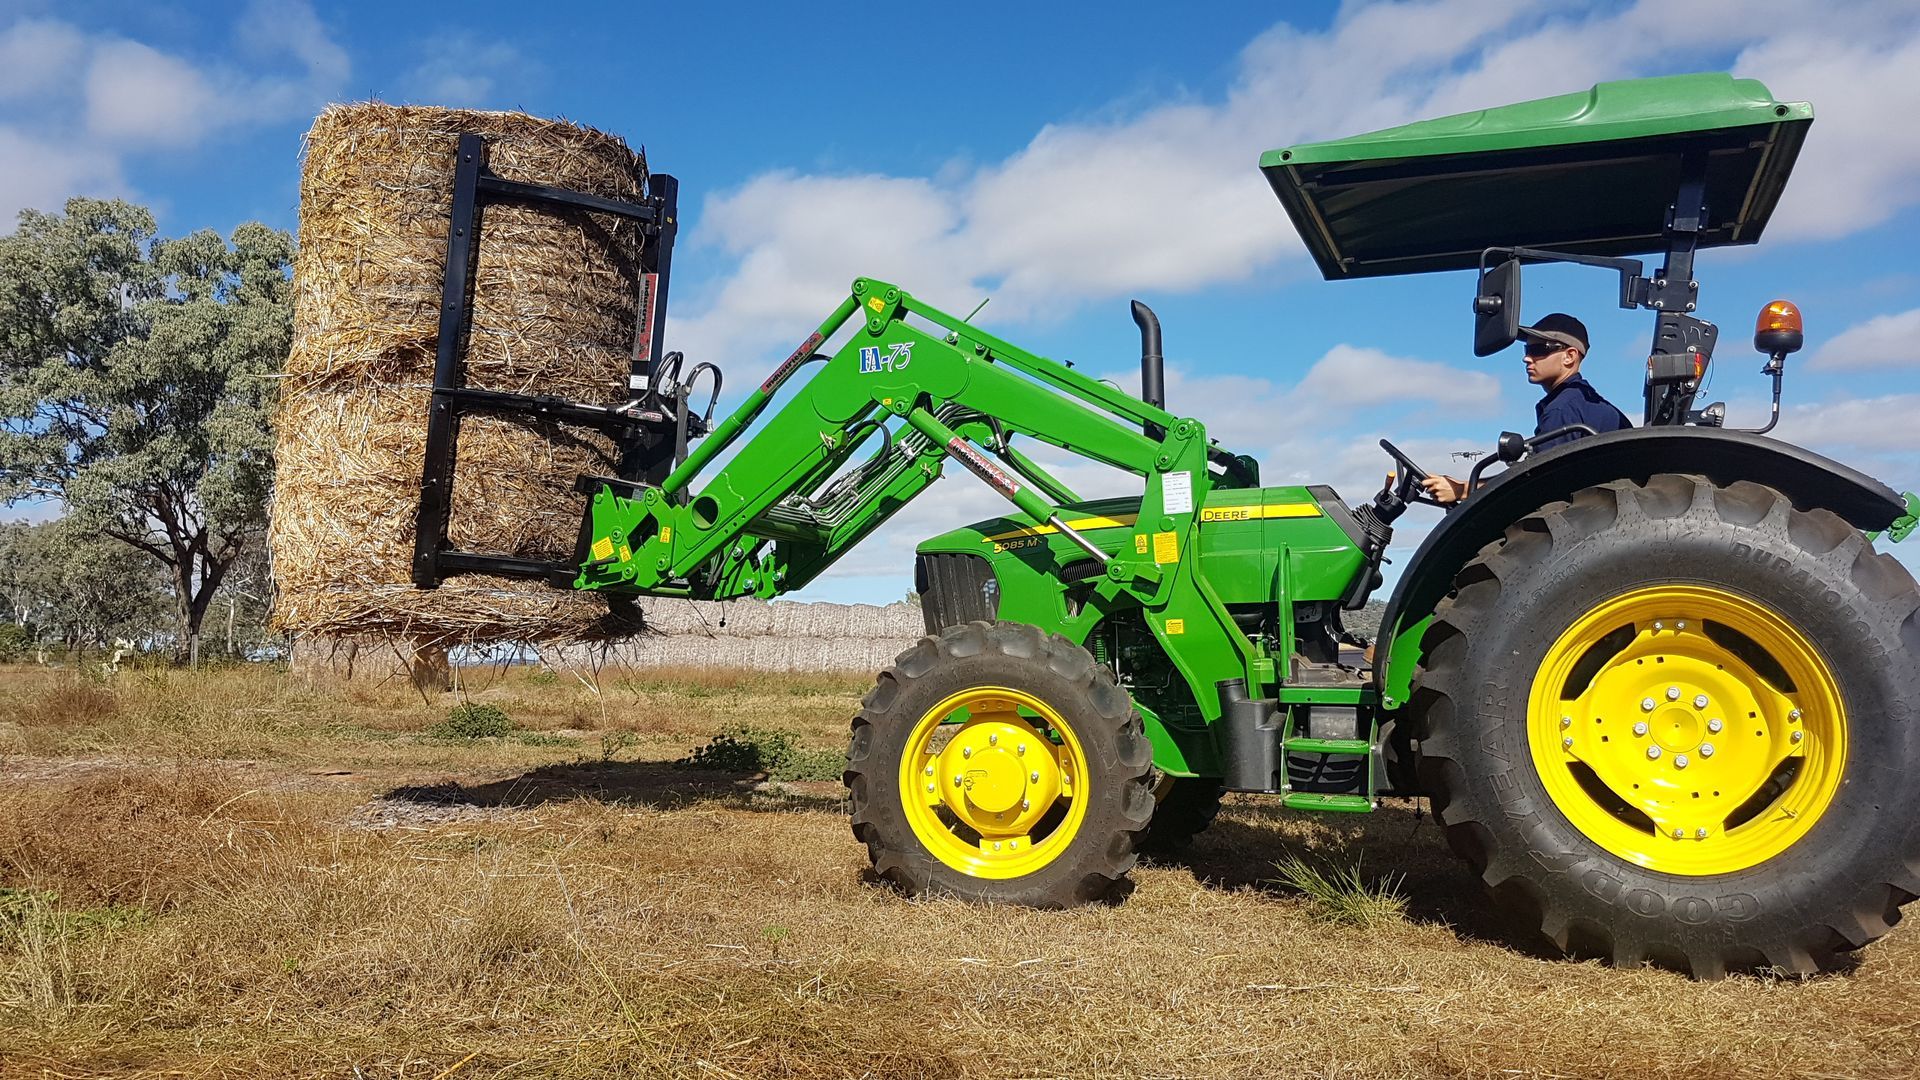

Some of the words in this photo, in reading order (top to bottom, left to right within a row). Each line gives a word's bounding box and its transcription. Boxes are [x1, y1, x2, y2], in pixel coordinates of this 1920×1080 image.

[1203, 510, 1249, 521] DEERE
[993, 540, 1025, 554] 5085
[1027, 538, 1038, 548] M
